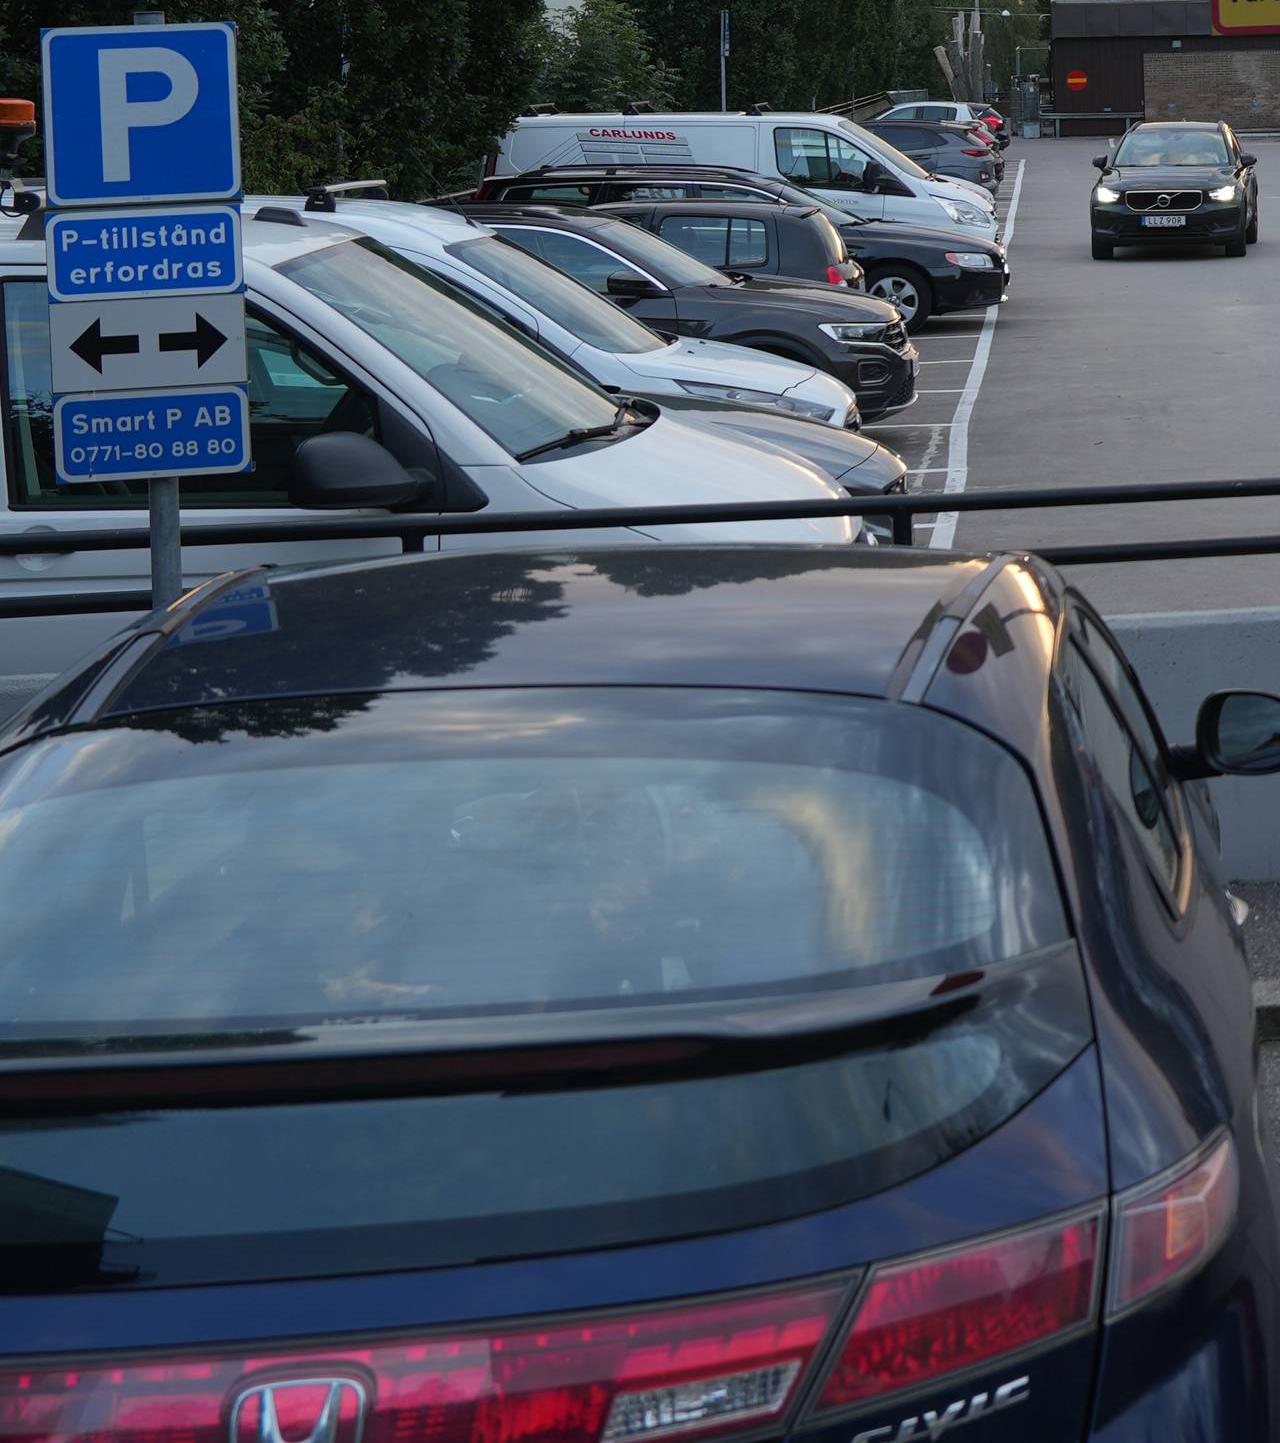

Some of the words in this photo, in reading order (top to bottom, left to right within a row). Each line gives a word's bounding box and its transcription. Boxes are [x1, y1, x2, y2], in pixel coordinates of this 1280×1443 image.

[98, 46, 199, 183] P
[589, 128, 677, 141] CARLUNDS
[62, 222, 226, 252] P-tillstånd
[70, 258, 222, 285] erfordras
[72, 410, 156, 435] Smart
[166, 408, 183, 430] P
[194, 405, 232, 428] AB
[70, 442, 164, 463] 0771-80
[172, 440, 199, 457] 88
[207, 437, 236, 455] 80
